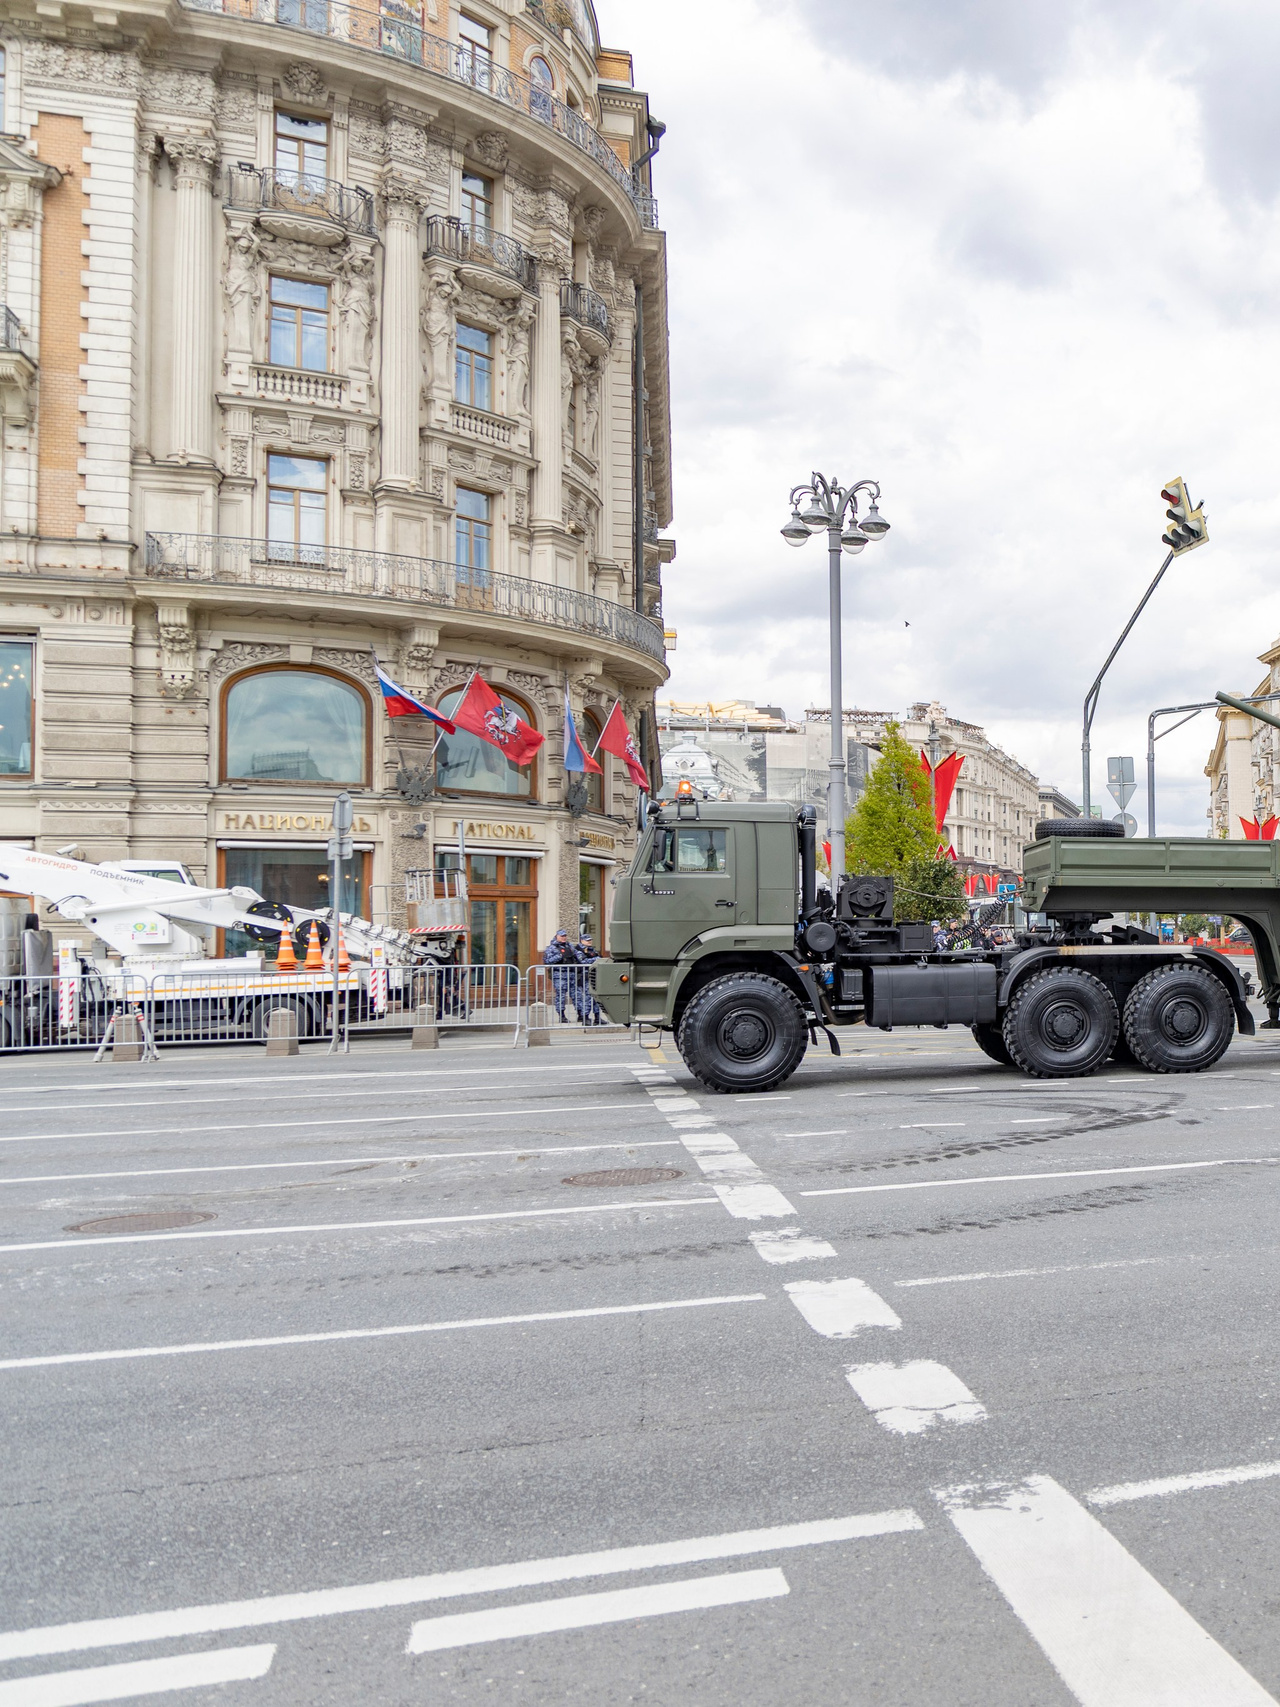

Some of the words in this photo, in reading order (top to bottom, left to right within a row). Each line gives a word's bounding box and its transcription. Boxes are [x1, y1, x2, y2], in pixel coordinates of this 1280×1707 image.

[224, 814, 372, 832] НАЦИОНЬ
[25, 856, 78, 871] АВТОГИДРО
[89, 868, 145, 886] ПОДЪЕМНИК
